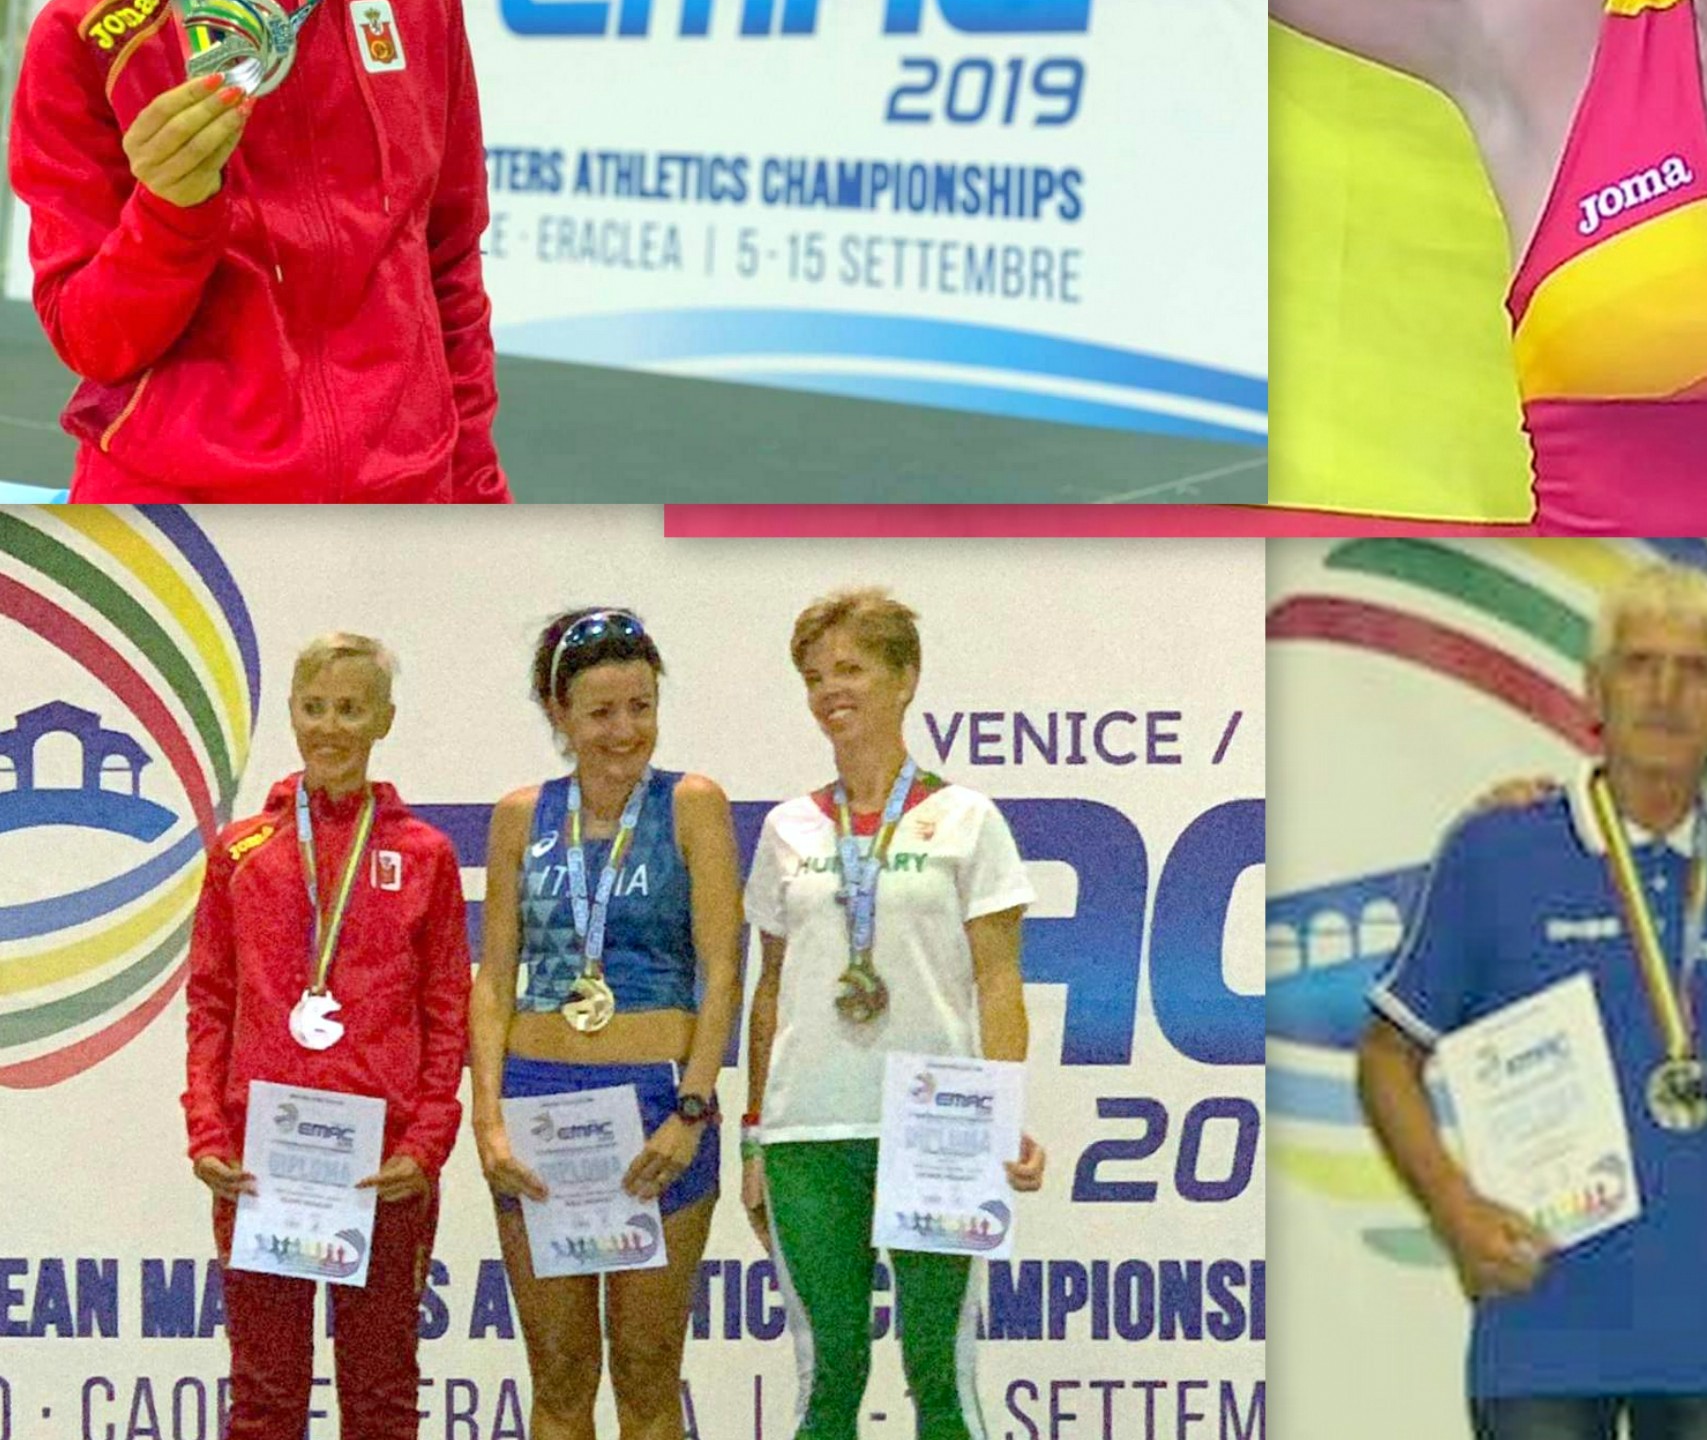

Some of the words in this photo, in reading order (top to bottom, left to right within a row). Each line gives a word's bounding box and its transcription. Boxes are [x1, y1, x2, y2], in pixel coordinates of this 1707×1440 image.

[883, 55, 1085, 127] 2019
[573, 150, 749, 205] ATHLETICS
[761, 155, 1085, 223] CHAMPIONSHIPS
[1574, 153, 1693, 235] Joma
[536, 218, 684, 271] ERACLEA
[837, 238, 1084, 304] SETTEMBRE
[923, 711, 1183, 767] VENICE
